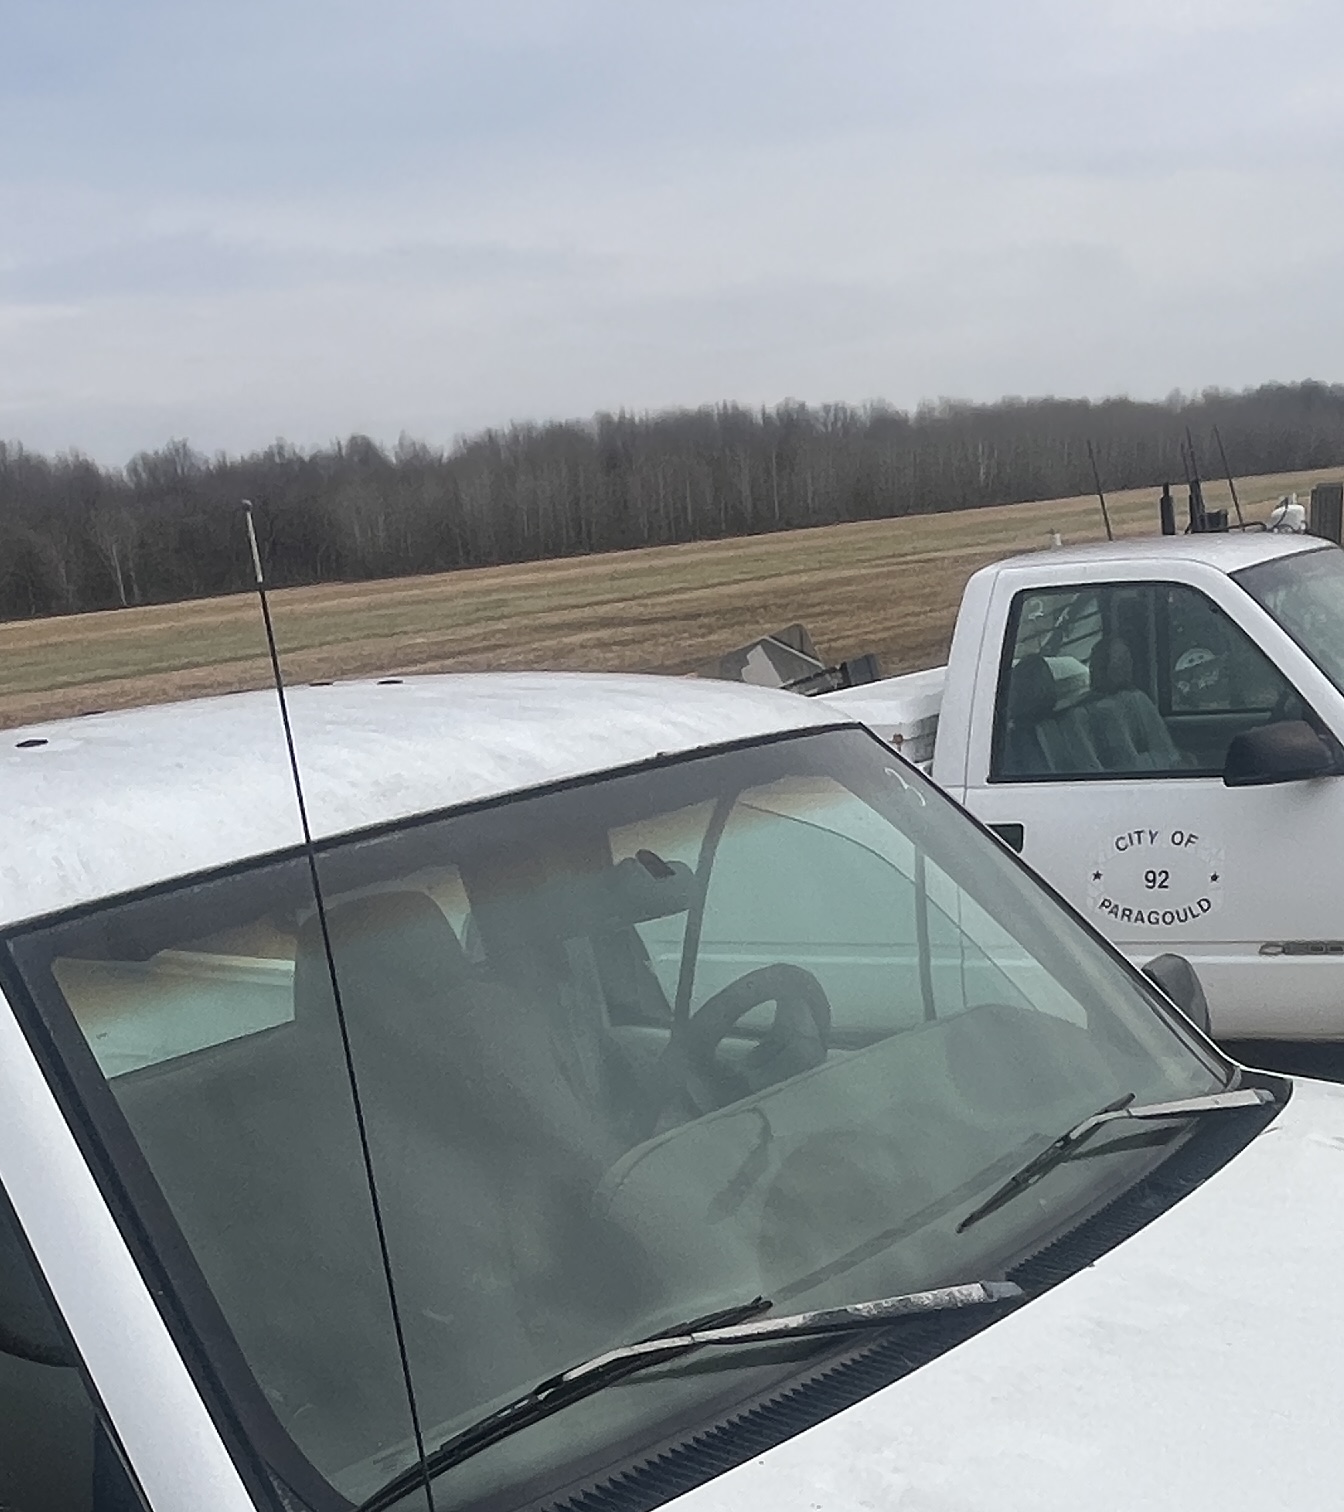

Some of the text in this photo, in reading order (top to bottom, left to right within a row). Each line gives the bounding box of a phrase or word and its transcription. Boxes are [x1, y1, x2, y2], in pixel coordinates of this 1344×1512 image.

[1115, 829, 1199, 851] CITY OF
[1144, 870, 1170, 889] 92
[1098, 898, 1212, 926] PARAGOULD
